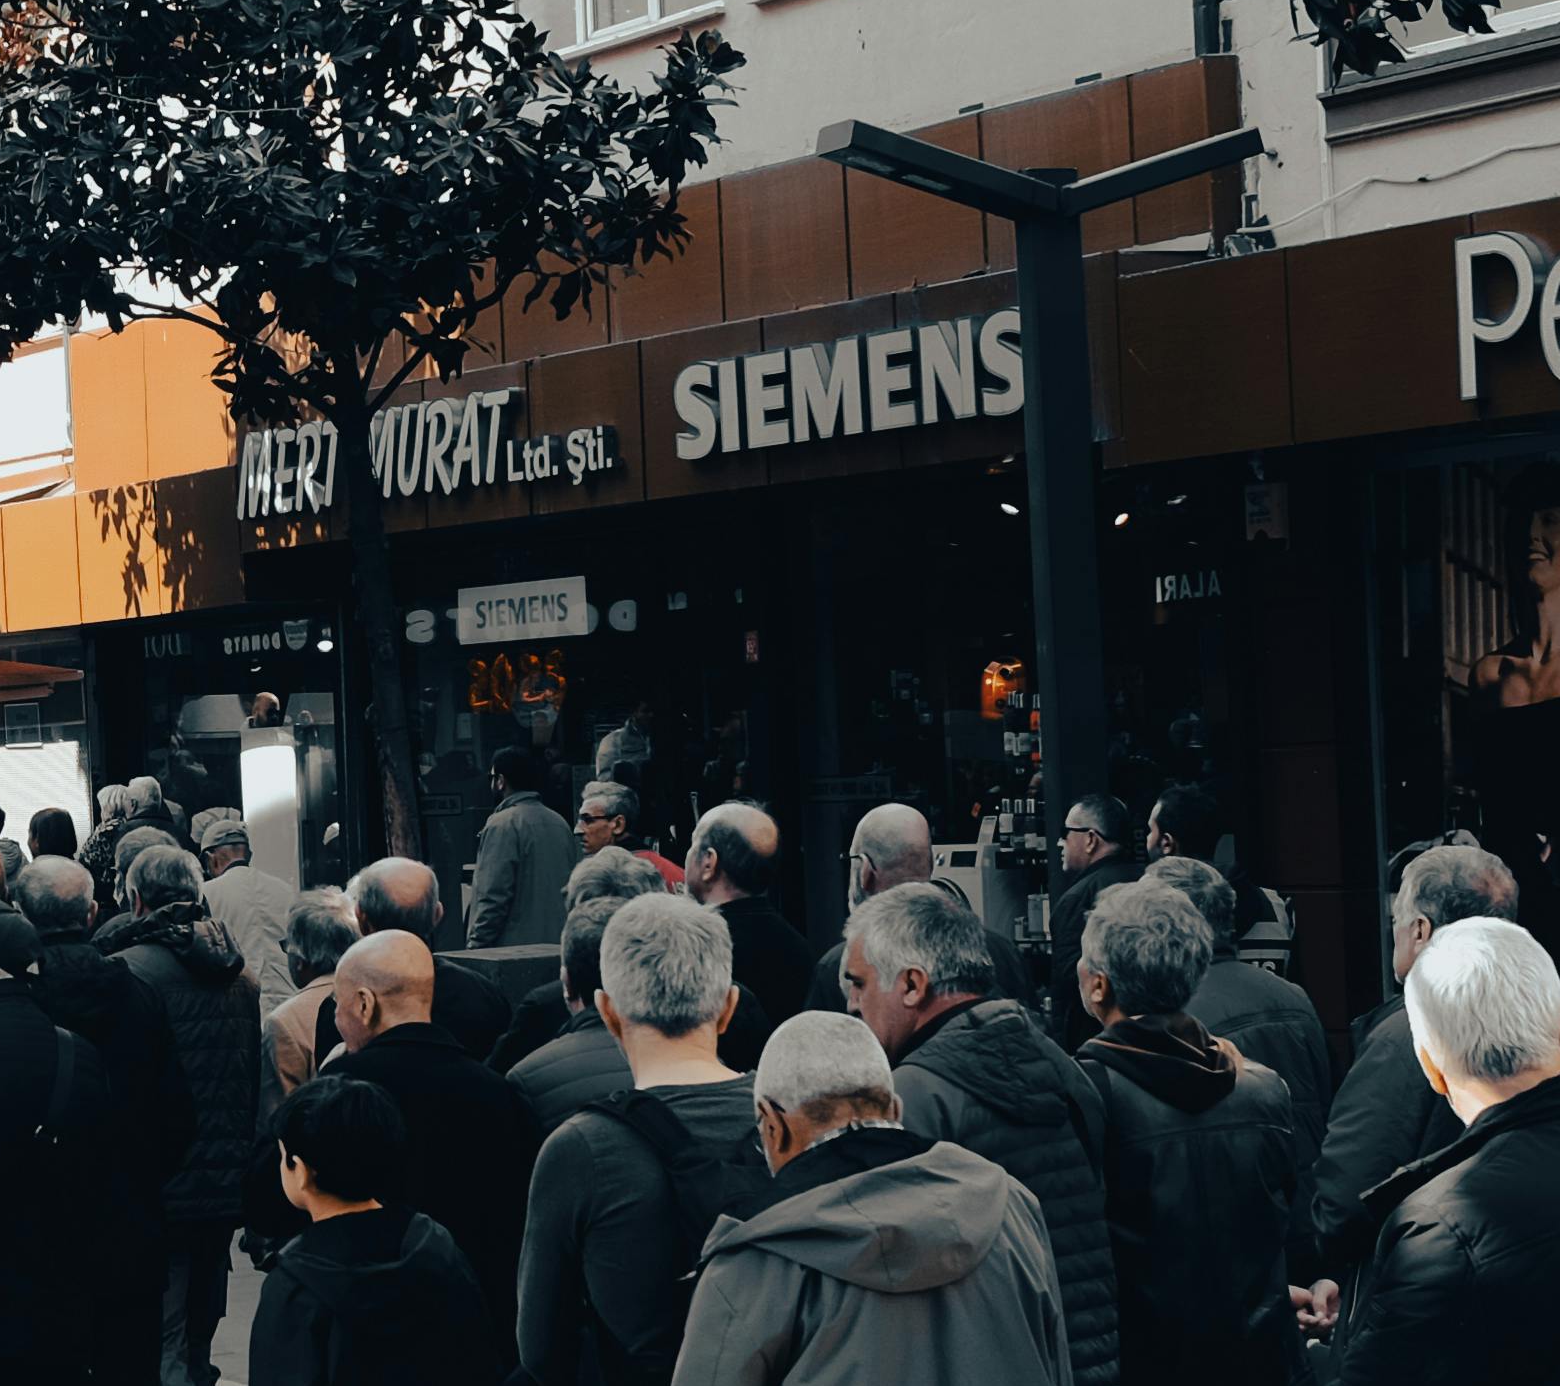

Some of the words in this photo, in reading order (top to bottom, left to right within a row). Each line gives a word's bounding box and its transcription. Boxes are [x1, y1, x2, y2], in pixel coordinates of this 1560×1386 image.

[674, 306, 1026, 463] SIEMENS
[237, 421, 339, 521] MERT
[507, 435, 560, 484] Ltd.
[566, 424, 614, 486] Şti.
[475, 593, 568, 630] SIEMENS
